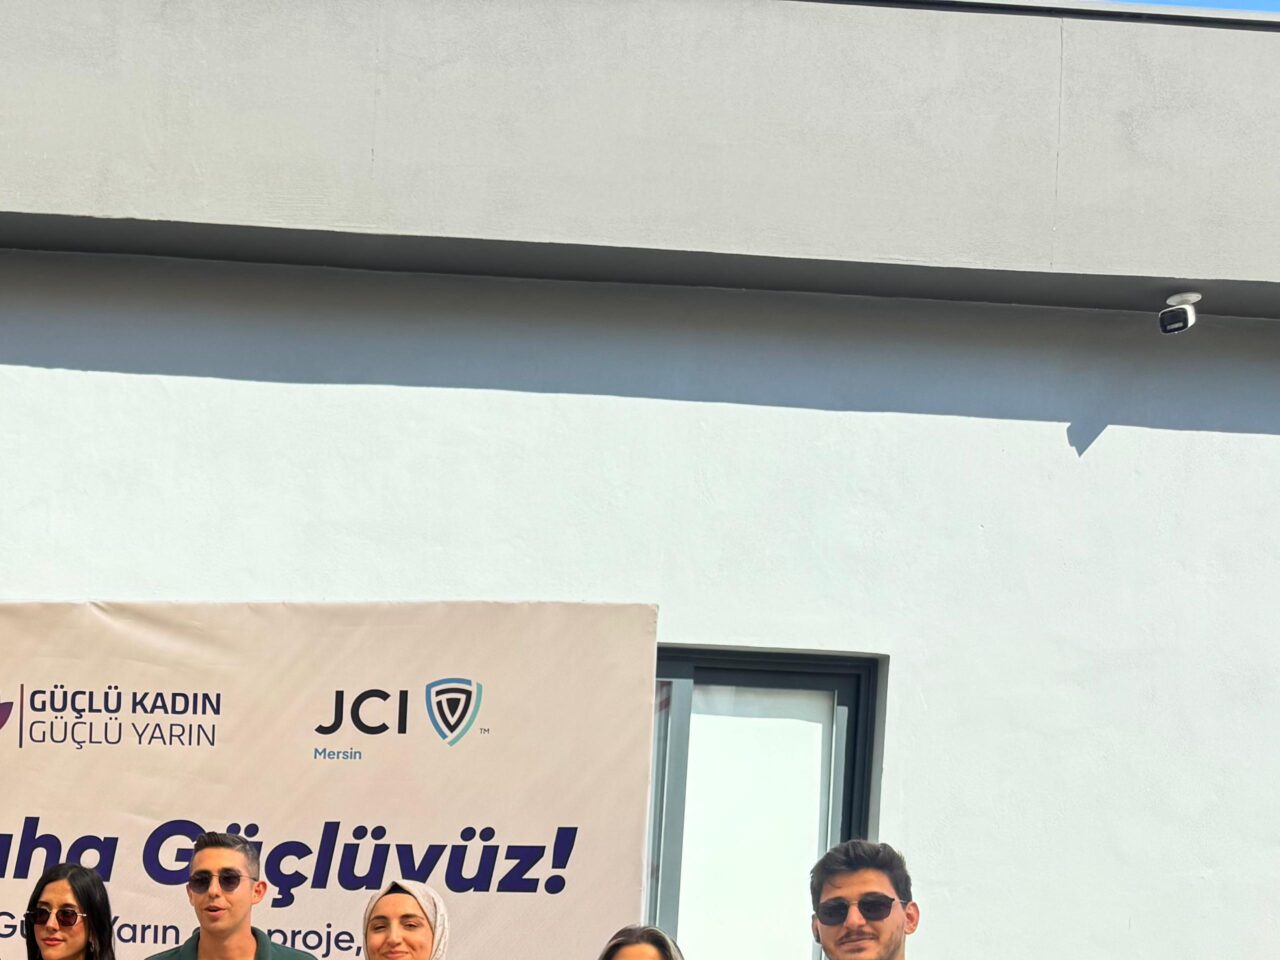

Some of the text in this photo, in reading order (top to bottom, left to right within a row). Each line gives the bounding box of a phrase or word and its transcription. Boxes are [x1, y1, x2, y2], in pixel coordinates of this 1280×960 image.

[29, 684, 221, 719] GÜÇLÜ KADIN
[314, 688, 409, 735] JCI
[29, 716, 216, 750] GÜÇLÜ YARIN
[313, 747, 362, 761] Mersin
[266, 922, 363, 958] proje,
